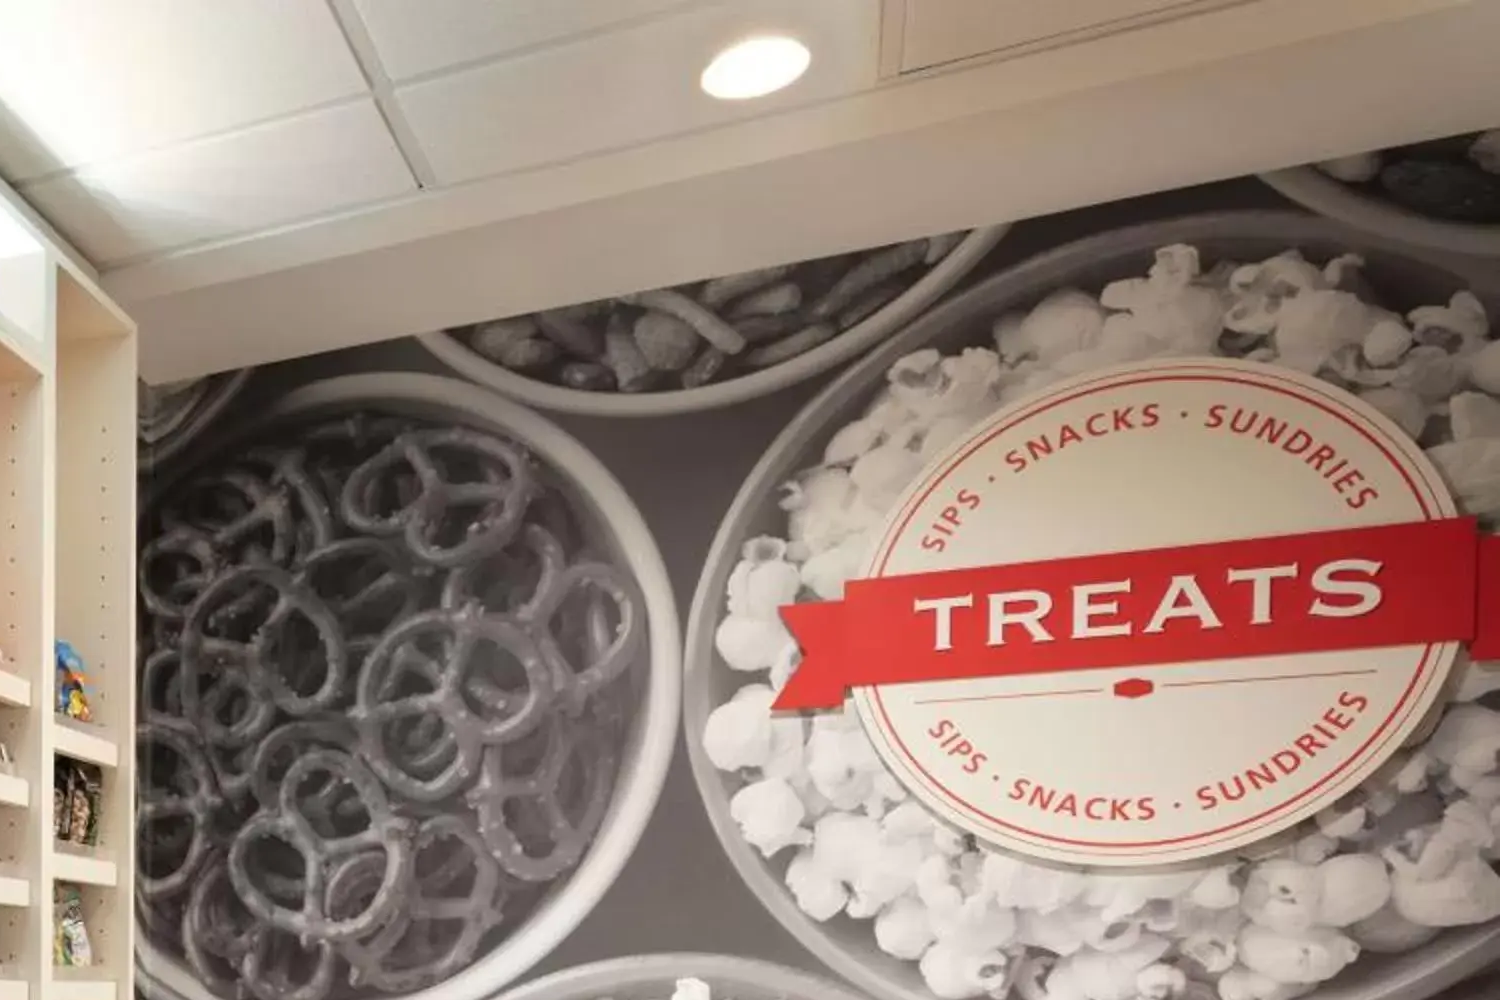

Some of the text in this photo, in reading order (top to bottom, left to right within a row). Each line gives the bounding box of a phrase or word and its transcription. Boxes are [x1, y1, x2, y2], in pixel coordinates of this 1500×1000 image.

[922, 403, 1379, 553] SIPS SNACKS SUNDRIES
[913, 557, 1384, 652] TREATS
[928, 690, 1369, 822] SIPS SNACKS SUNDRIES
